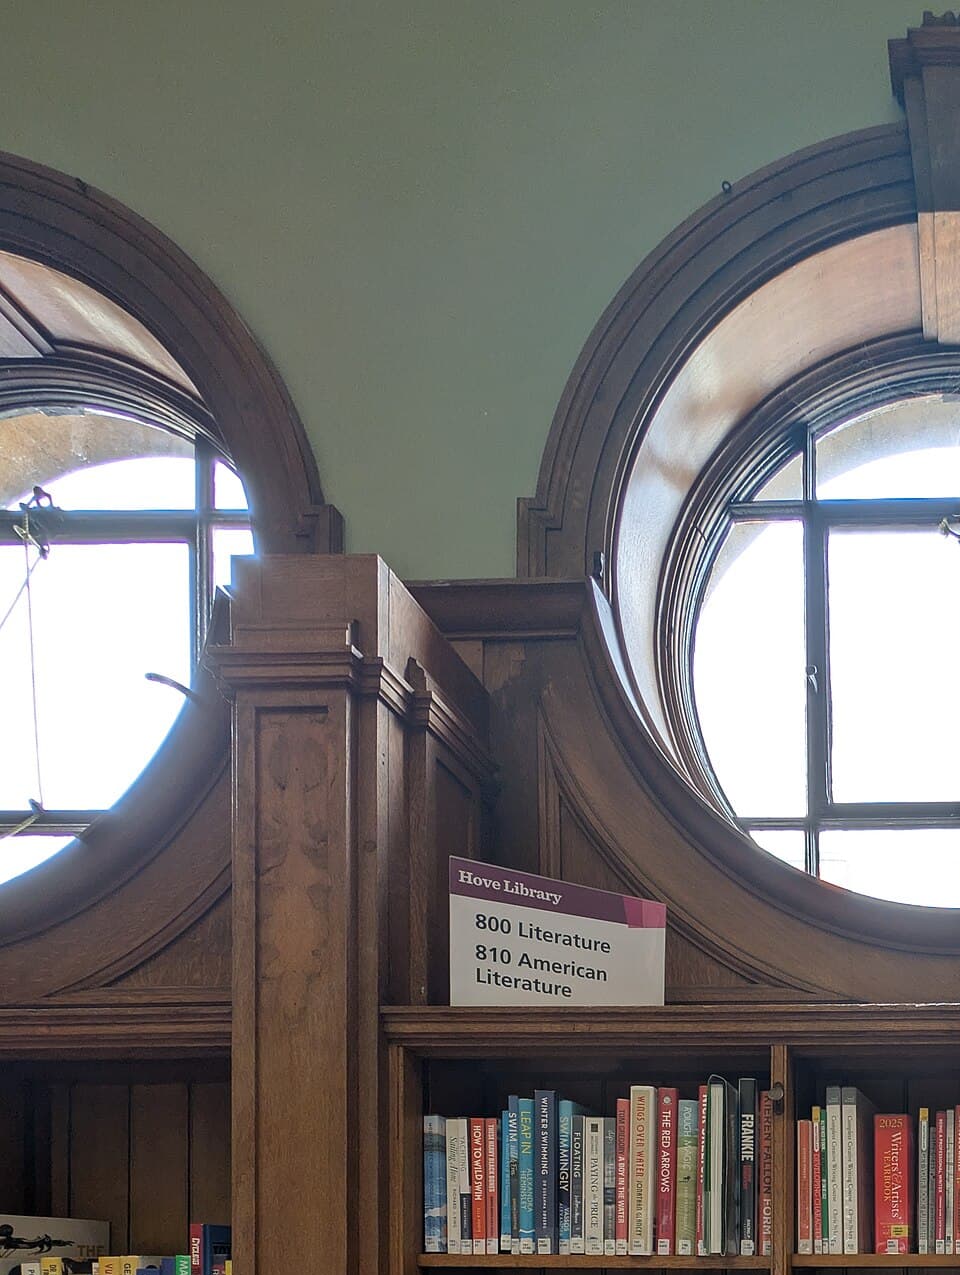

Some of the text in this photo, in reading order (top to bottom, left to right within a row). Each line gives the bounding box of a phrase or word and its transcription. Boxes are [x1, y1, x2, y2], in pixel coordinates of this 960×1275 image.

[458, 870, 563, 905] Hove Library
[476, 914, 610, 953] 800 Literature
[476, 944, 607, 982] 810 American
[476, 968, 572, 997] Literature
[509, 1113, 517, 1142] SWIM
[521, 1111, 530, 1154] LEAP IN
[636, 1096, 646, 1177] WINGS OVER WATER
[742, 1114, 753, 1161] FRANKIE
[880, 1119, 902, 1128] 2025
[474, 1147, 481, 1158] TO
[560, 1117, 569, 1191] SWIMMINGLY
[661, 1111, 671, 1192] THE RED ARROWS
[883, 1150, 891, 1202] YEARBOOK
[50, 1264, 57, 1273] DR
